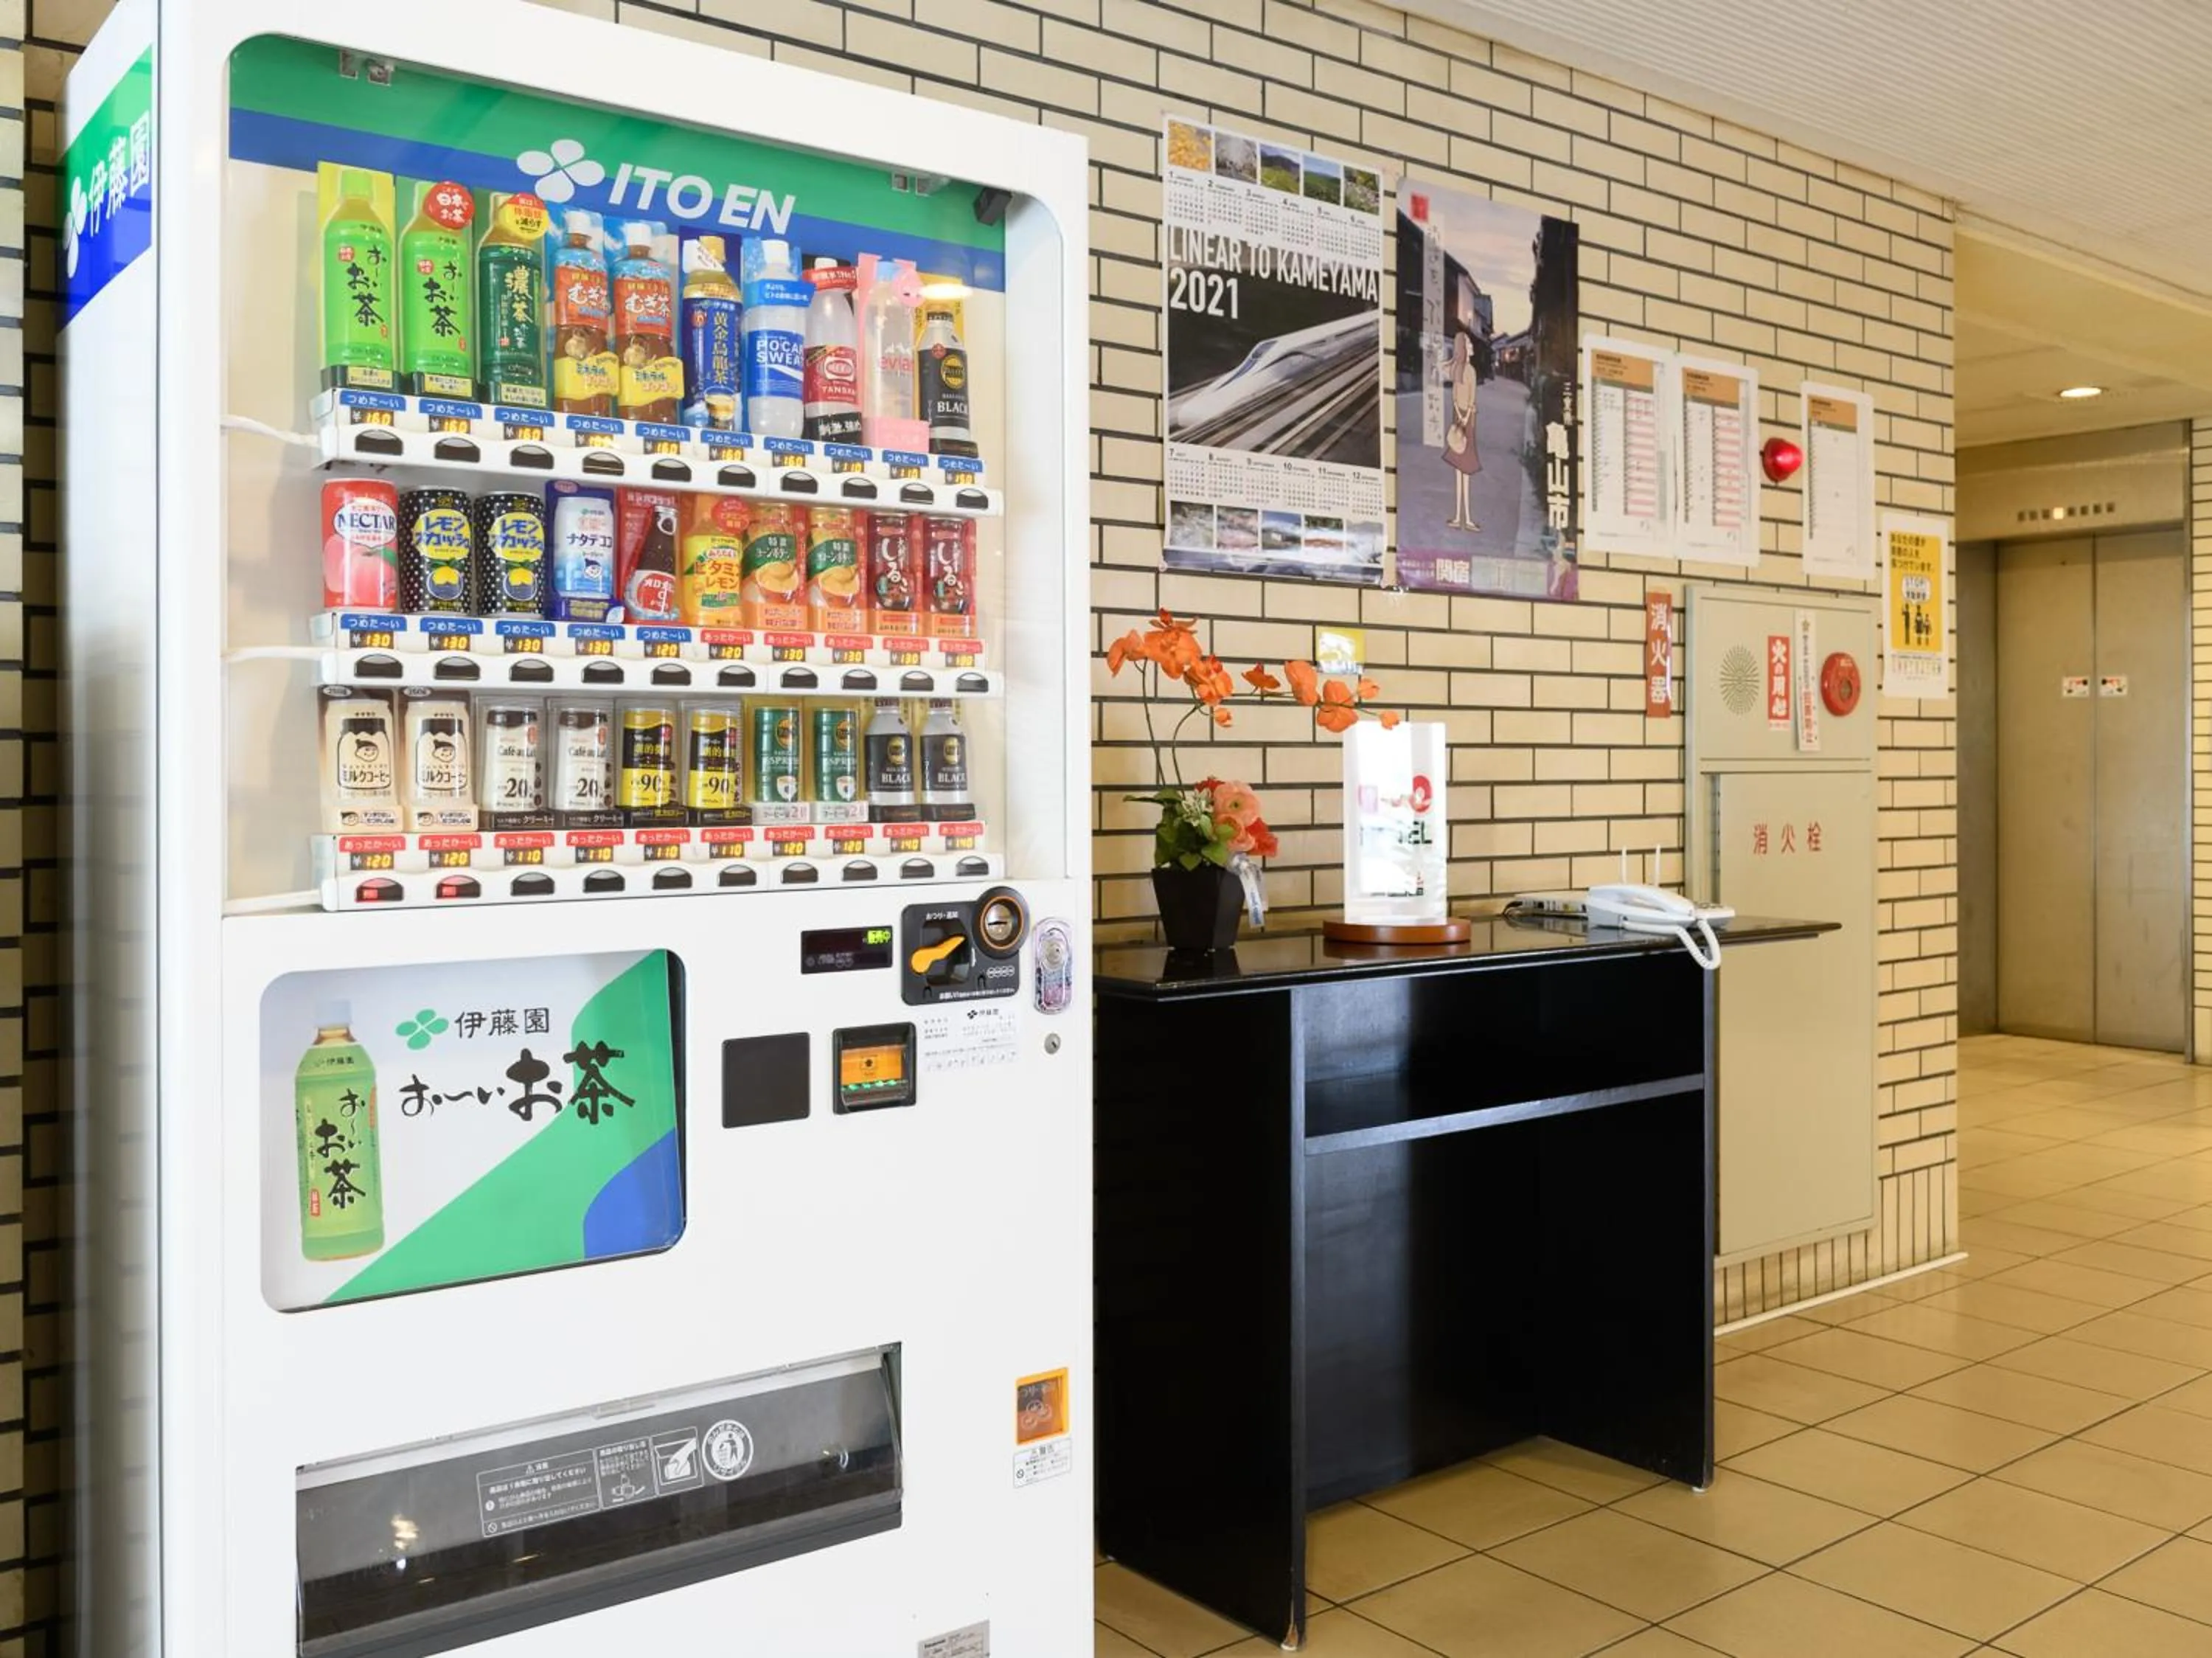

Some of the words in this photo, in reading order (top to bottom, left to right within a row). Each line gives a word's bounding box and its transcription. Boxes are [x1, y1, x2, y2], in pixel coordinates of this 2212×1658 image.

[88, 109, 150, 237] 伊藤園
[608, 162, 714, 219] ITO
[718, 184, 796, 235] EN
[1168, 223, 1242, 274] LINEAR
[1249, 244, 1270, 279] TO
[1277, 249, 1379, 303] KAMEYAMA
[1170, 267, 1238, 319] 2021
[337, 512, 397, 532] NECTAR
[424, 516, 465, 533] レモン
[501, 518, 540, 533] レモン
[705, 576, 738, 589] レモン
[1651, 603, 1668, 704] 消火器
[504, 777, 528, 799] 20
[709, 777, 730, 794] 90
[1753, 821, 1823, 856] 消火栓
[454, 1007, 549, 1039] 伊藤園
